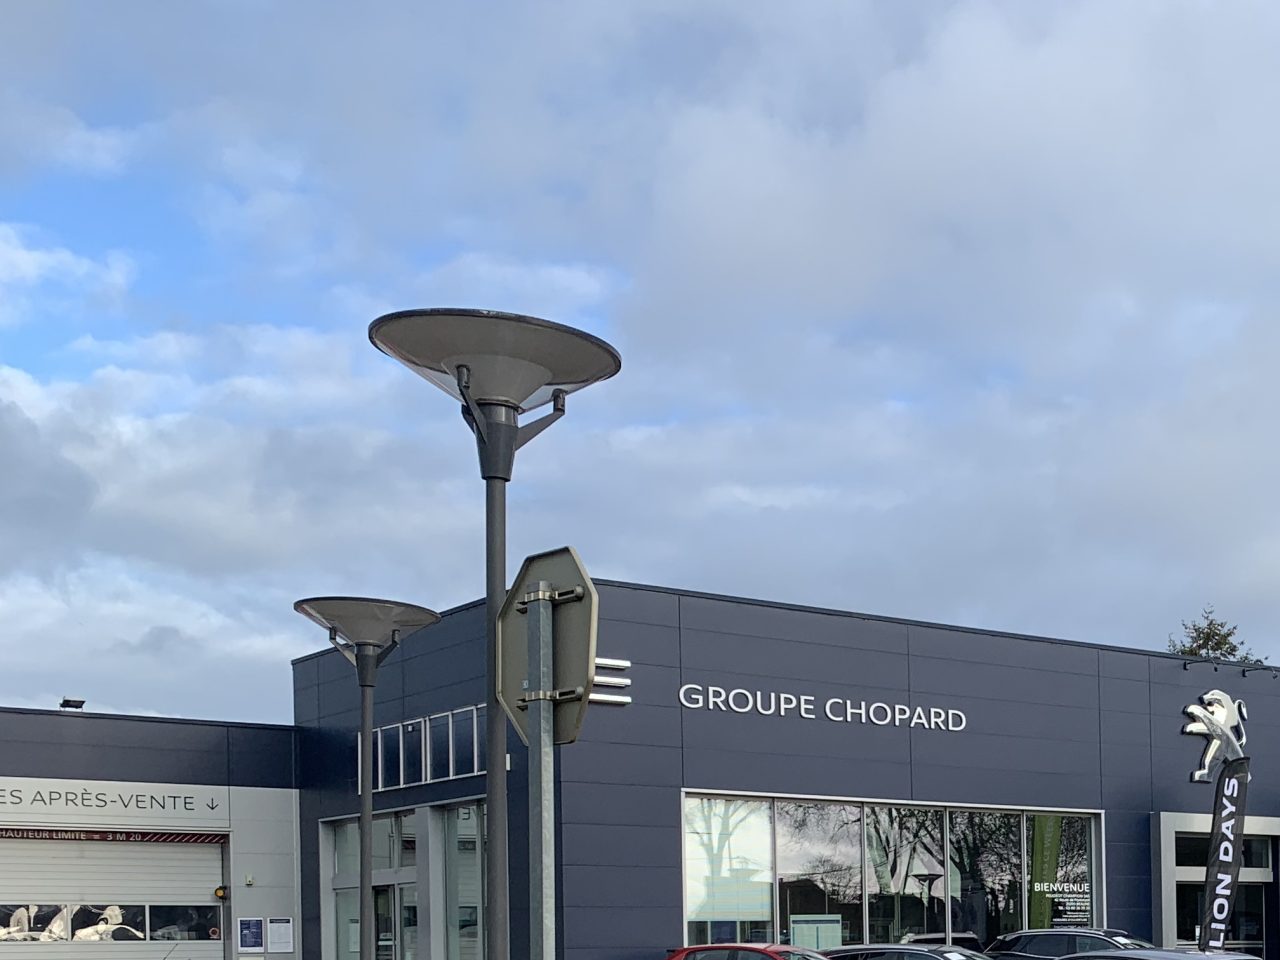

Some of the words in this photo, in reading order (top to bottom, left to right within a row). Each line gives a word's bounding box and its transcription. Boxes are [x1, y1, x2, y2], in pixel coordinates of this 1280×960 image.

[678, 684, 816, 719] GROUPE
[824, 698, 968, 731] CHOPARD
[30, 788, 195, 811] APRÈS-VENTE
[52, 831, 87, 840] LIMITE
[106, 832, 113, 841] 3
[116, 833, 126, 841] M
[129, 833, 142, 841] 20
[1218, 777, 1239, 863] DAYS
[1034, 882, 1091, 892] BIENVENUE
[1208, 872, 1232, 948] LION
